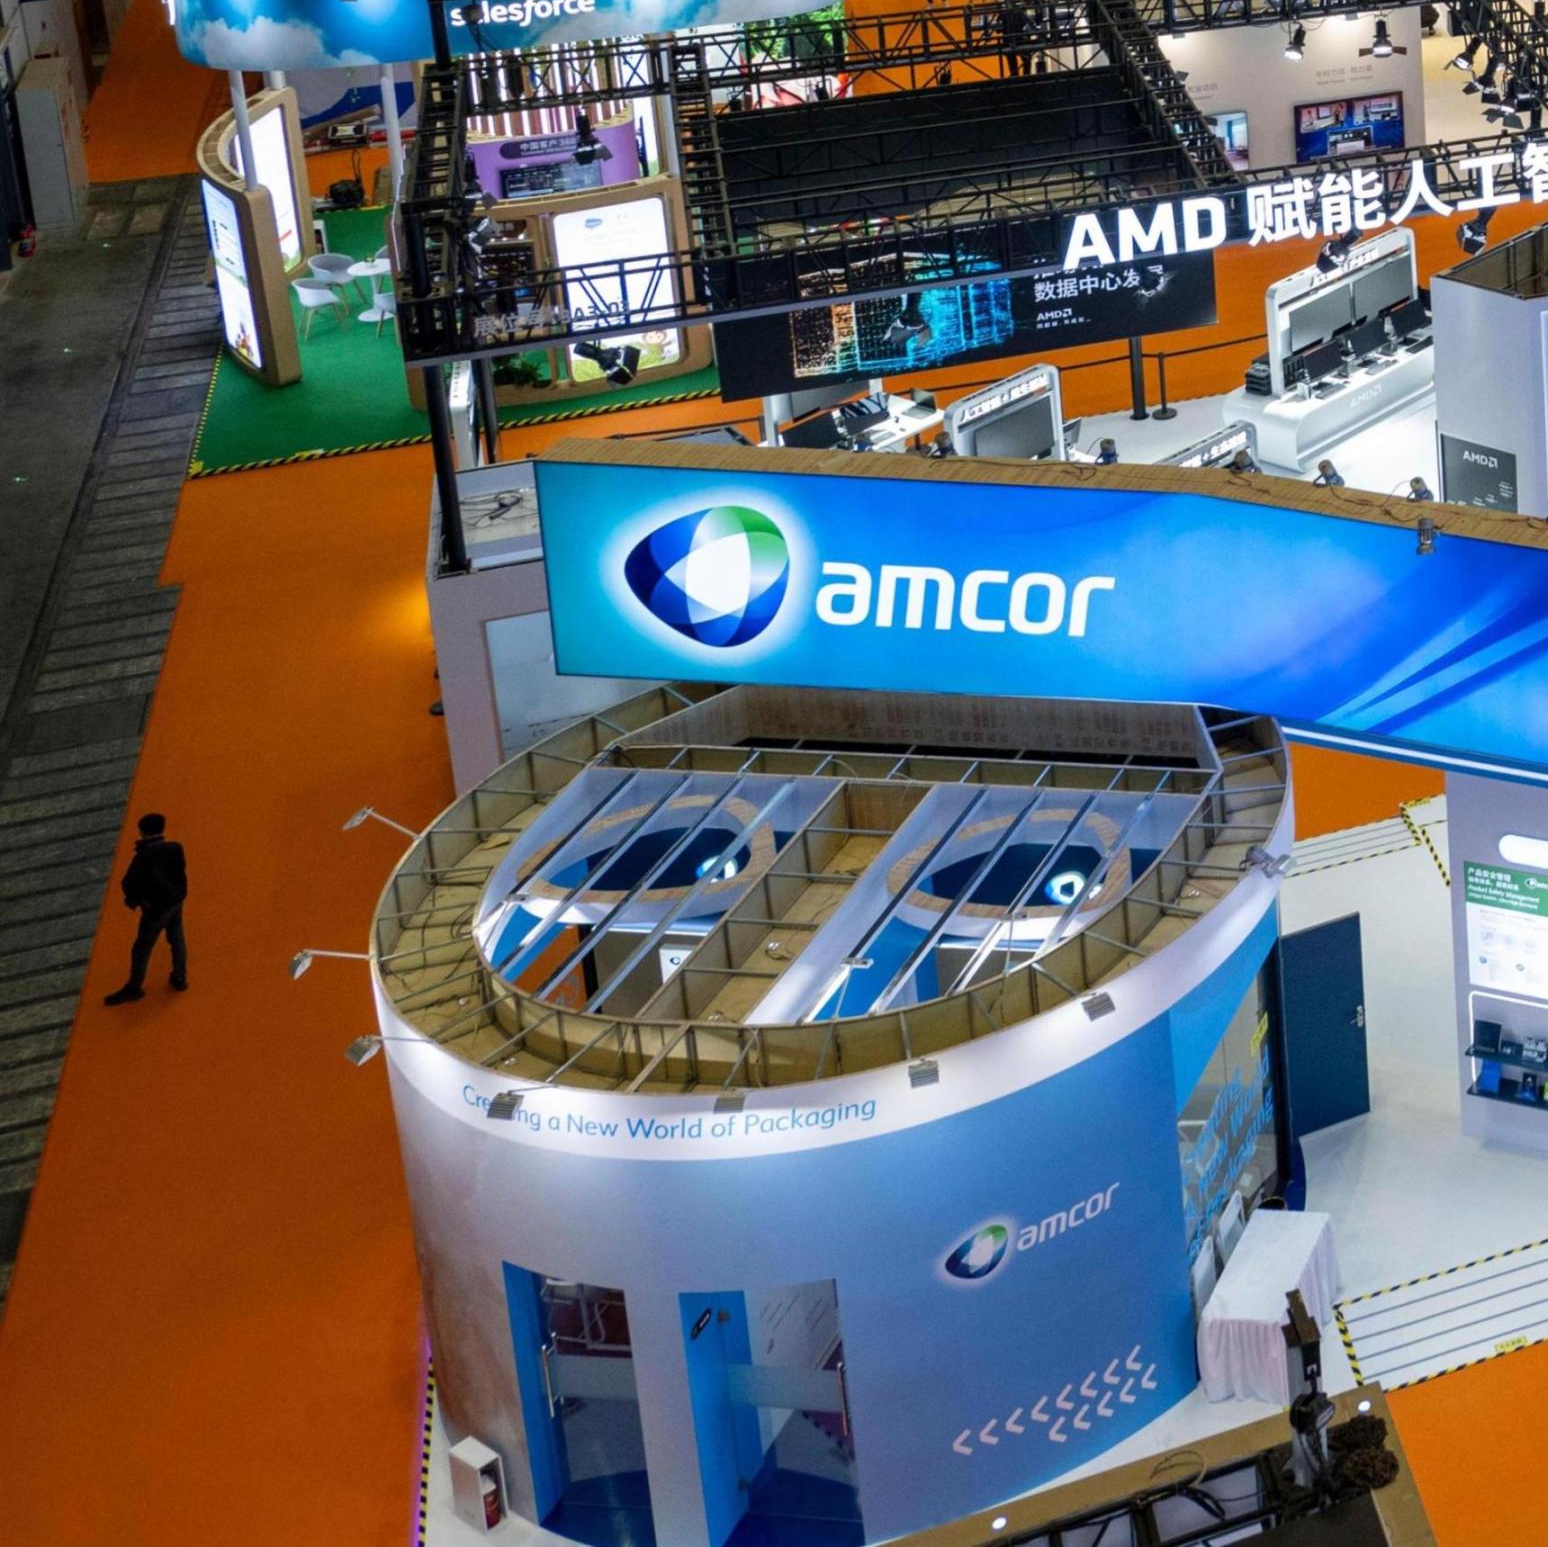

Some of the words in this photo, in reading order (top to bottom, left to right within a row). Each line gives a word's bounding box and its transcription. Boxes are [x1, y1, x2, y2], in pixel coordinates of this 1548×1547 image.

[1063, 196, 1226, 271] AMD
[1036, 308, 1063, 322] AMD
[1462, 449, 1489, 466] AMD
[816, 562, 1115, 637] amcor
[547, 1116, 561, 1132] a
[568, 1112, 619, 1138] New
[625, 1113, 701, 1140] World
[710, 1110, 737, 1139] of
[744, 1095, 877, 1136] Packaging
[1015, 1180, 1120, 1252] amcor
